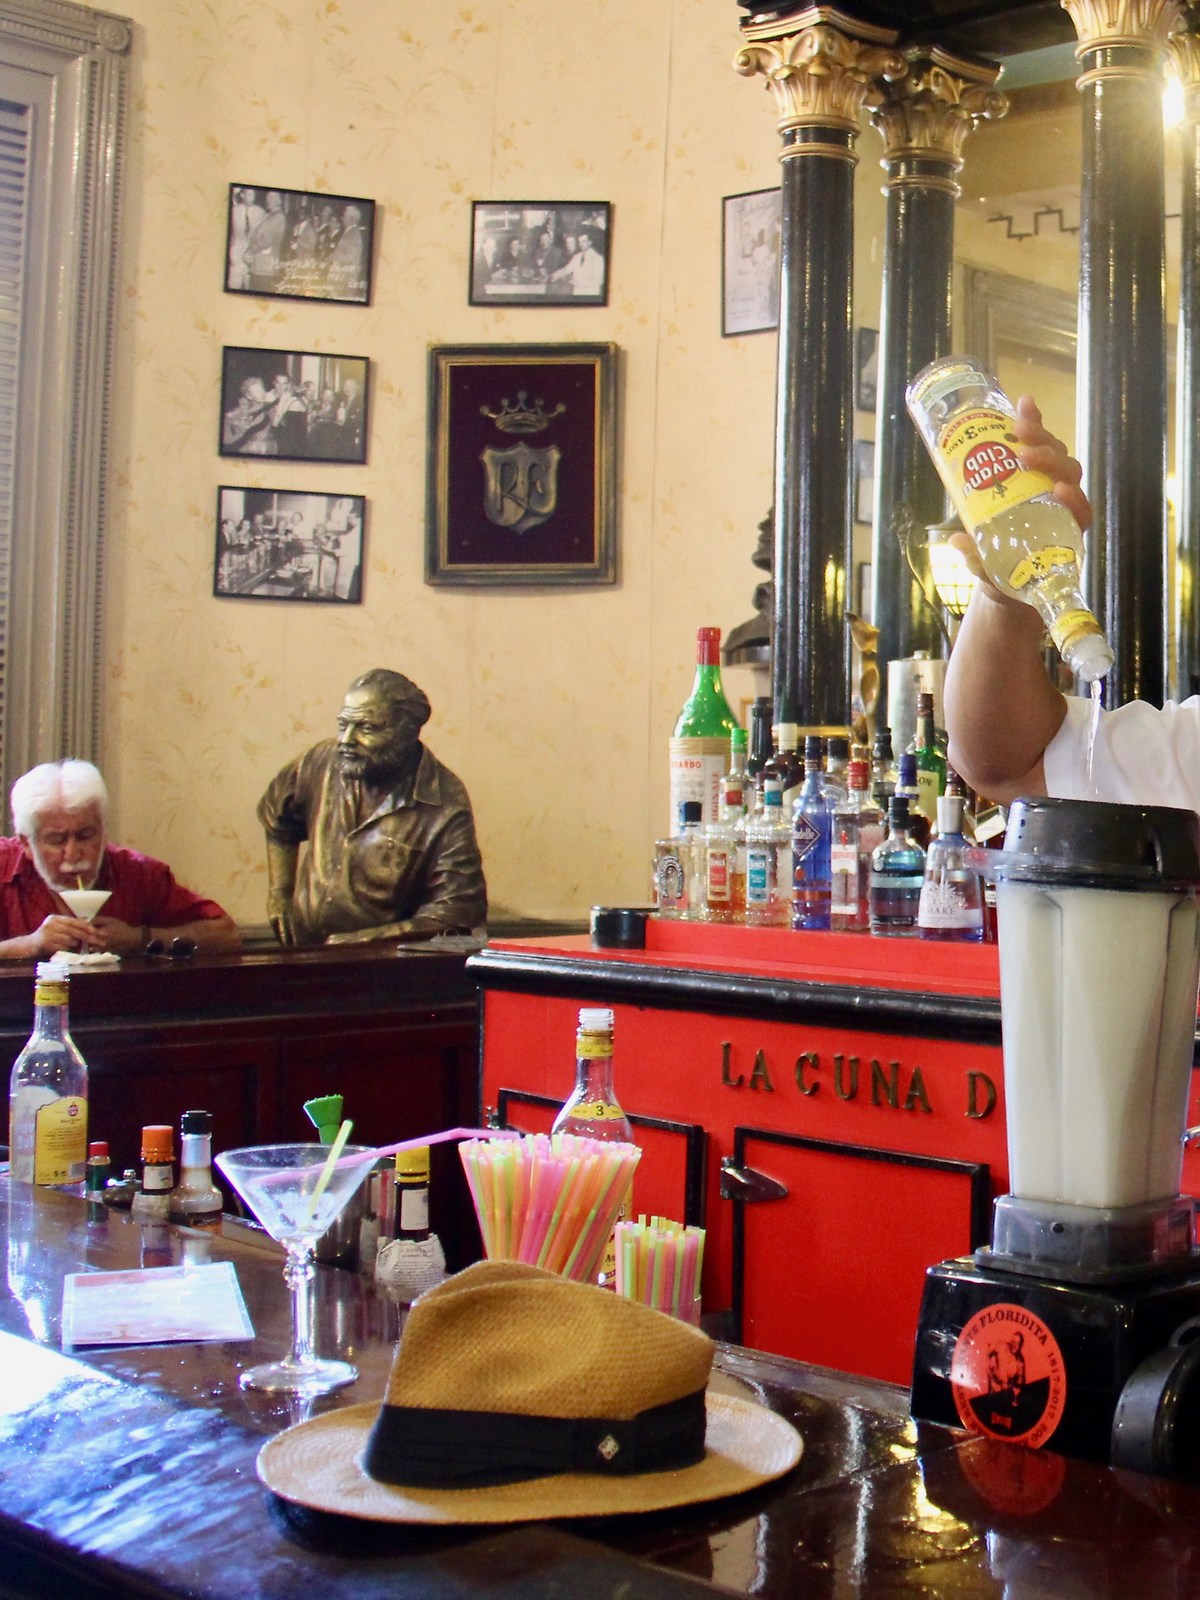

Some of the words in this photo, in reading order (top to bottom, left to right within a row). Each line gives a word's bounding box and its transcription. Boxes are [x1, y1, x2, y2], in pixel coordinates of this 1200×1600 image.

[965, 425, 979, 440] 3
[965, 445, 1008, 472] Club
[720, 1042, 774, 1092] LA
[794, 1051, 933, 1114] CUNA
[596, 1105, 605, 1117] 3
[979, 1308, 1049, 1347] FLORIDITA
